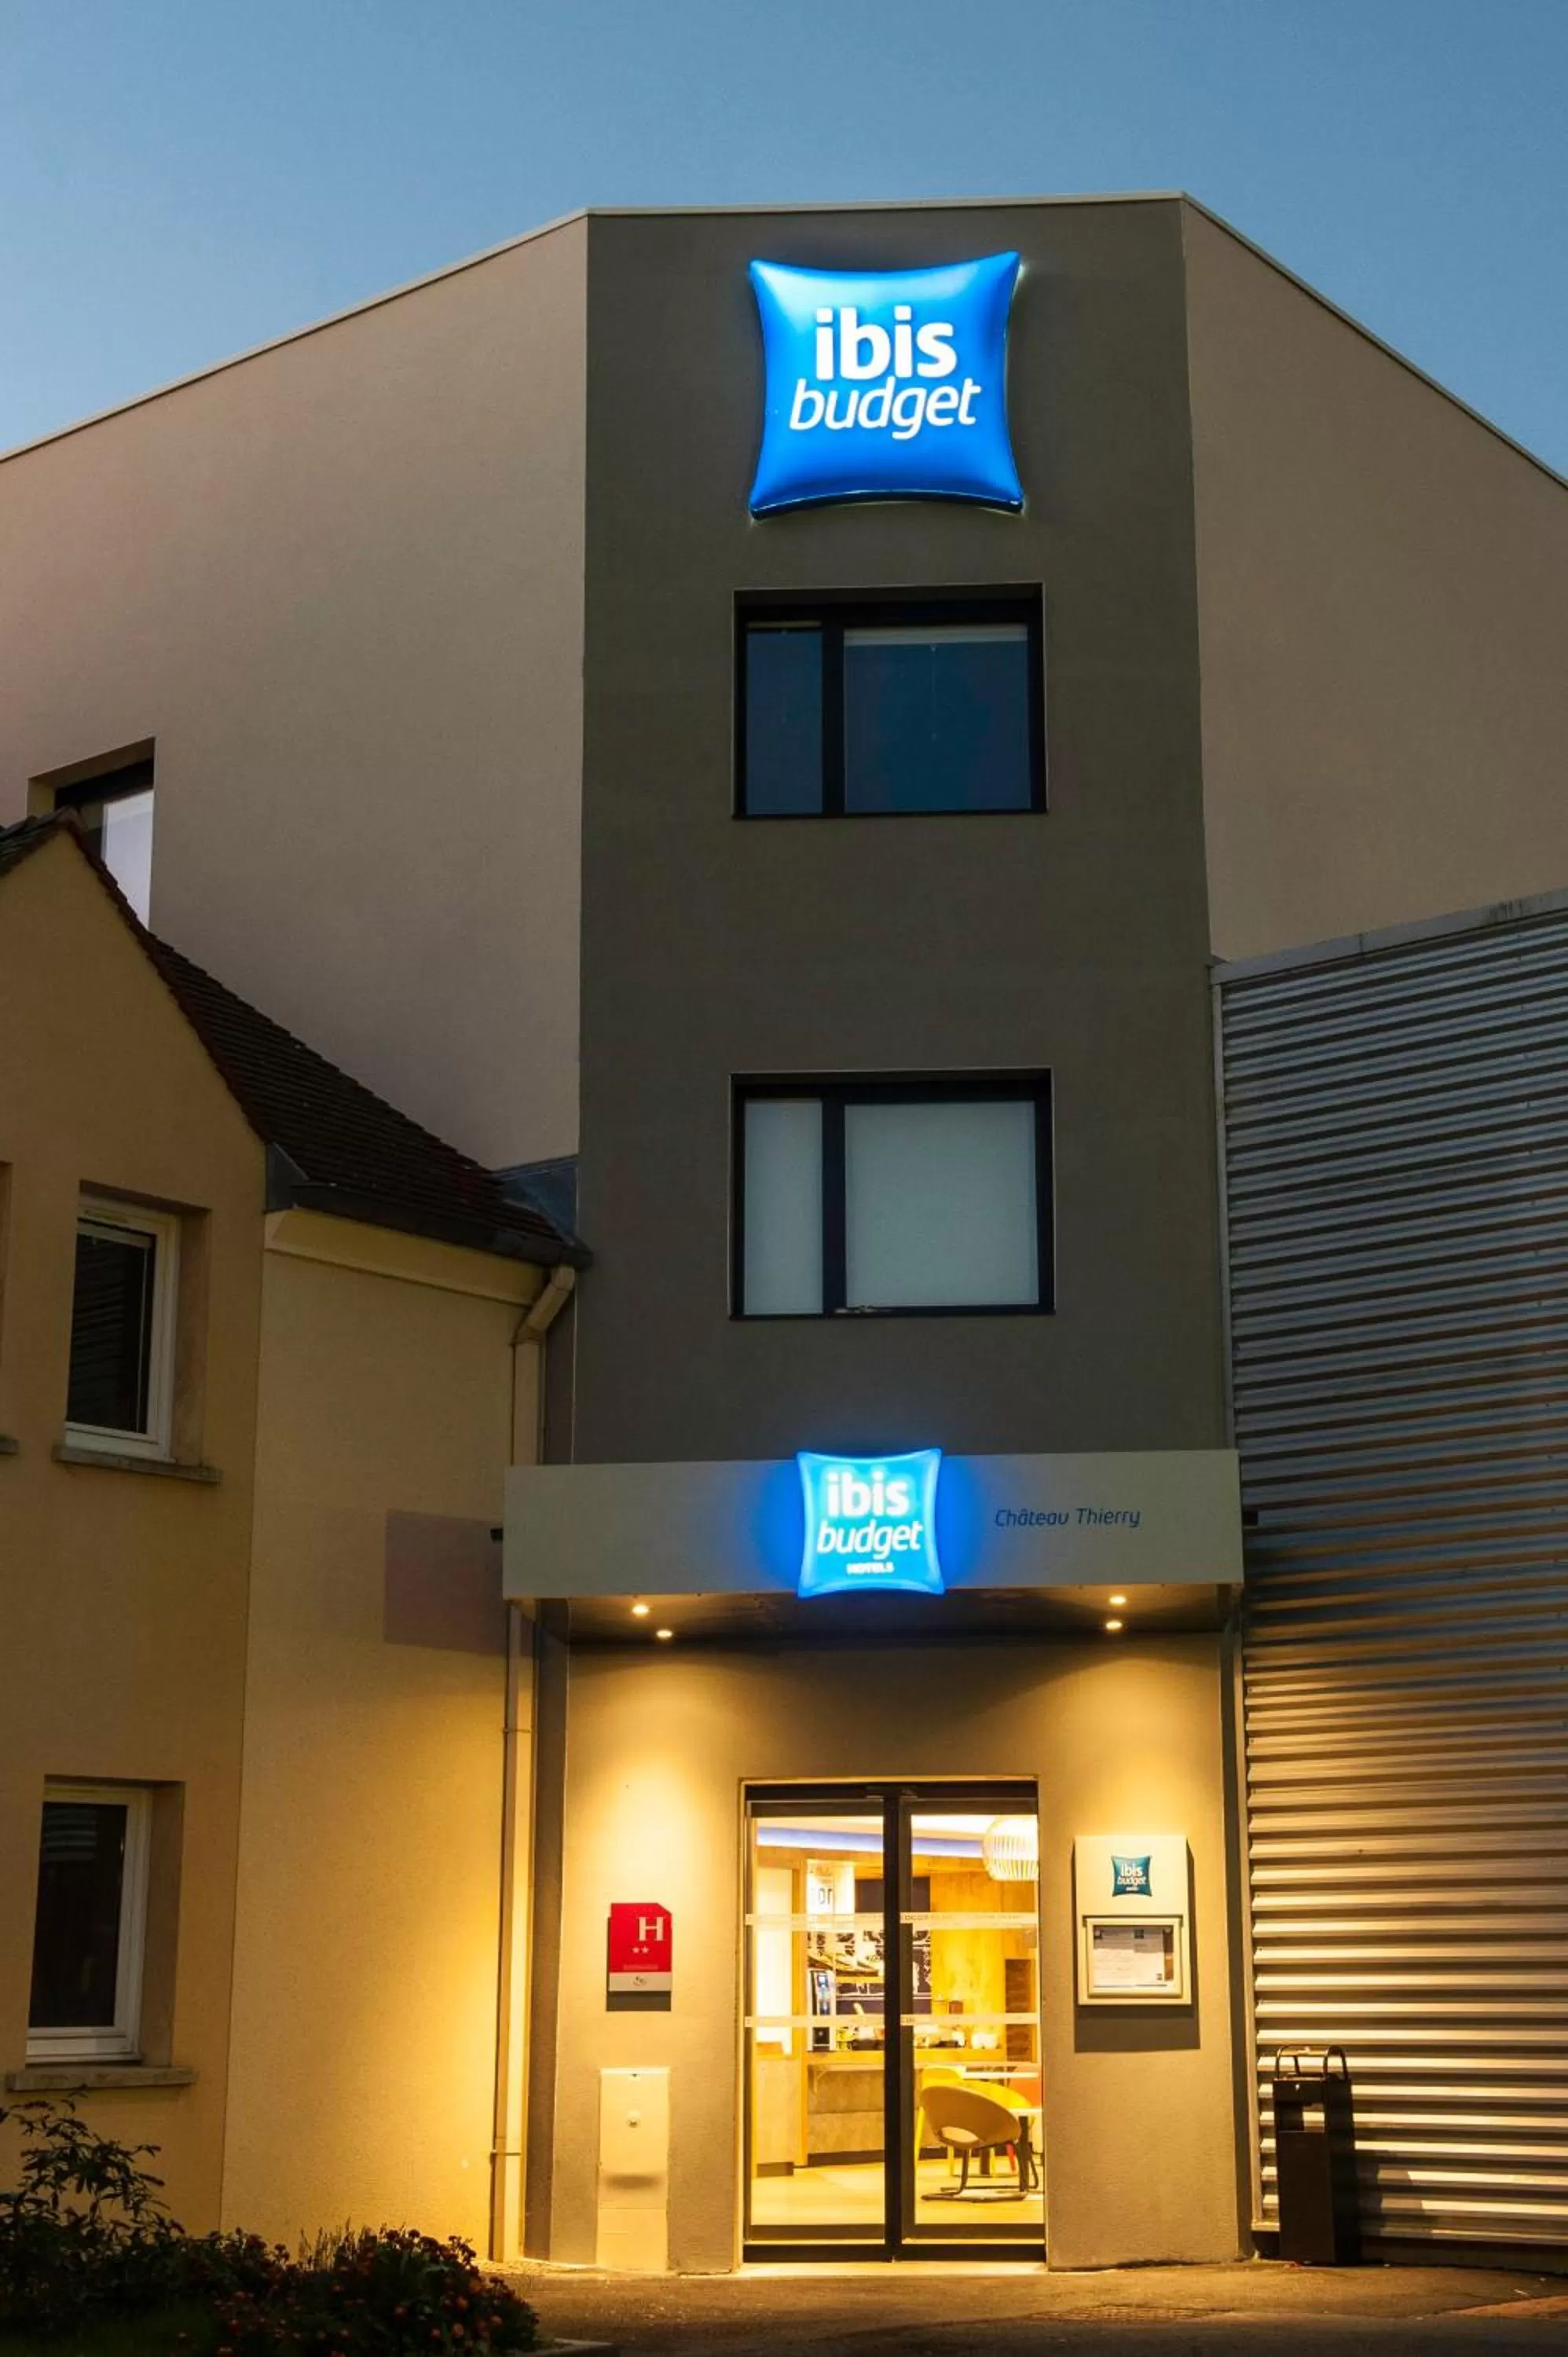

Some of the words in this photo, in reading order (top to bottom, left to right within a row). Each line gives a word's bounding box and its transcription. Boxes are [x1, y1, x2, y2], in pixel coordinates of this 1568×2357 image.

[815, 304, 958, 381] ibis
[789, 376, 981, 440] budget
[827, 1471, 910, 1517] ibis
[995, 1508, 1069, 1527] Château
[1075, 1507, 1141, 1528] Thierry
[816, 1518, 925, 1560] budget
[1116, 1876, 1146, 1886] budget
[1120, 1863, 1144, 1877] ibis
[638, 1916, 665, 1941] H
